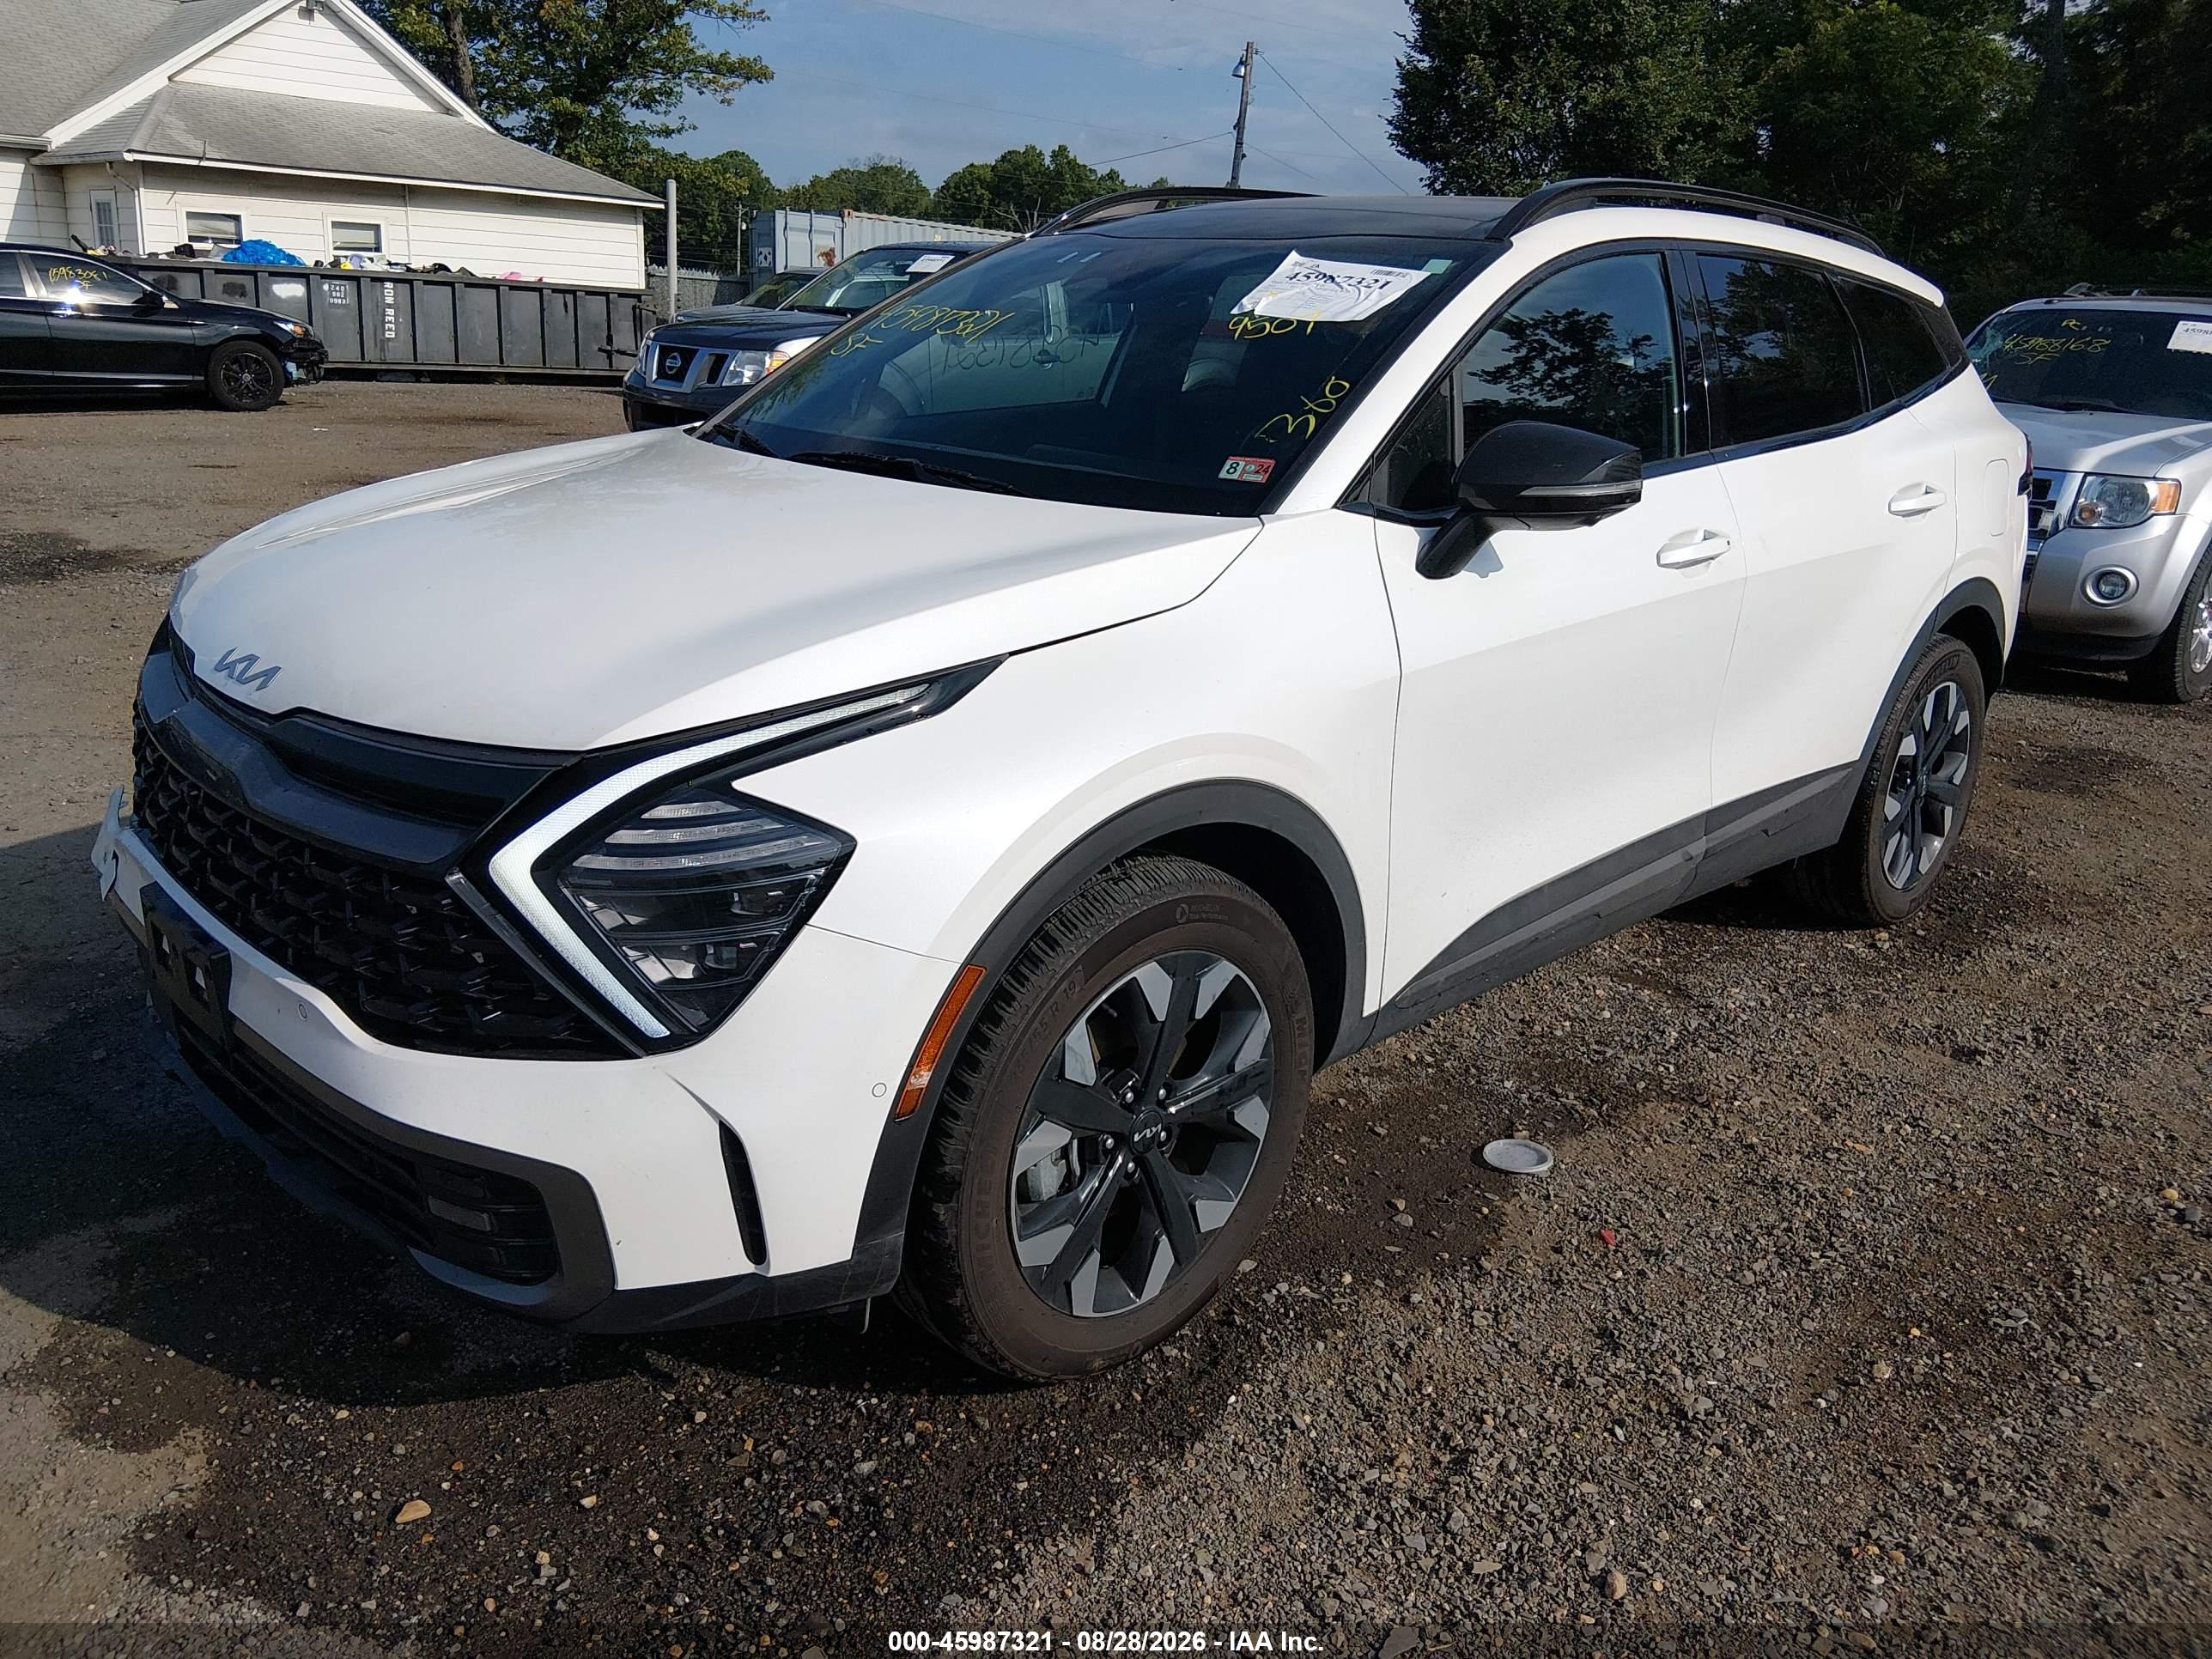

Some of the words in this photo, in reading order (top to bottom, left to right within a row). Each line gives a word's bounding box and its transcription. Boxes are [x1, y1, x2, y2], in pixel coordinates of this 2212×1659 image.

[1285, 270, 1393, 290] 45987321
[383, 281, 394, 305] RON
[385, 307, 396, 338] REED
[1225, 461, 1240, 475] 8
[1255, 464, 1272, 475] 24
[1063, 981, 1077, 1000] 19
